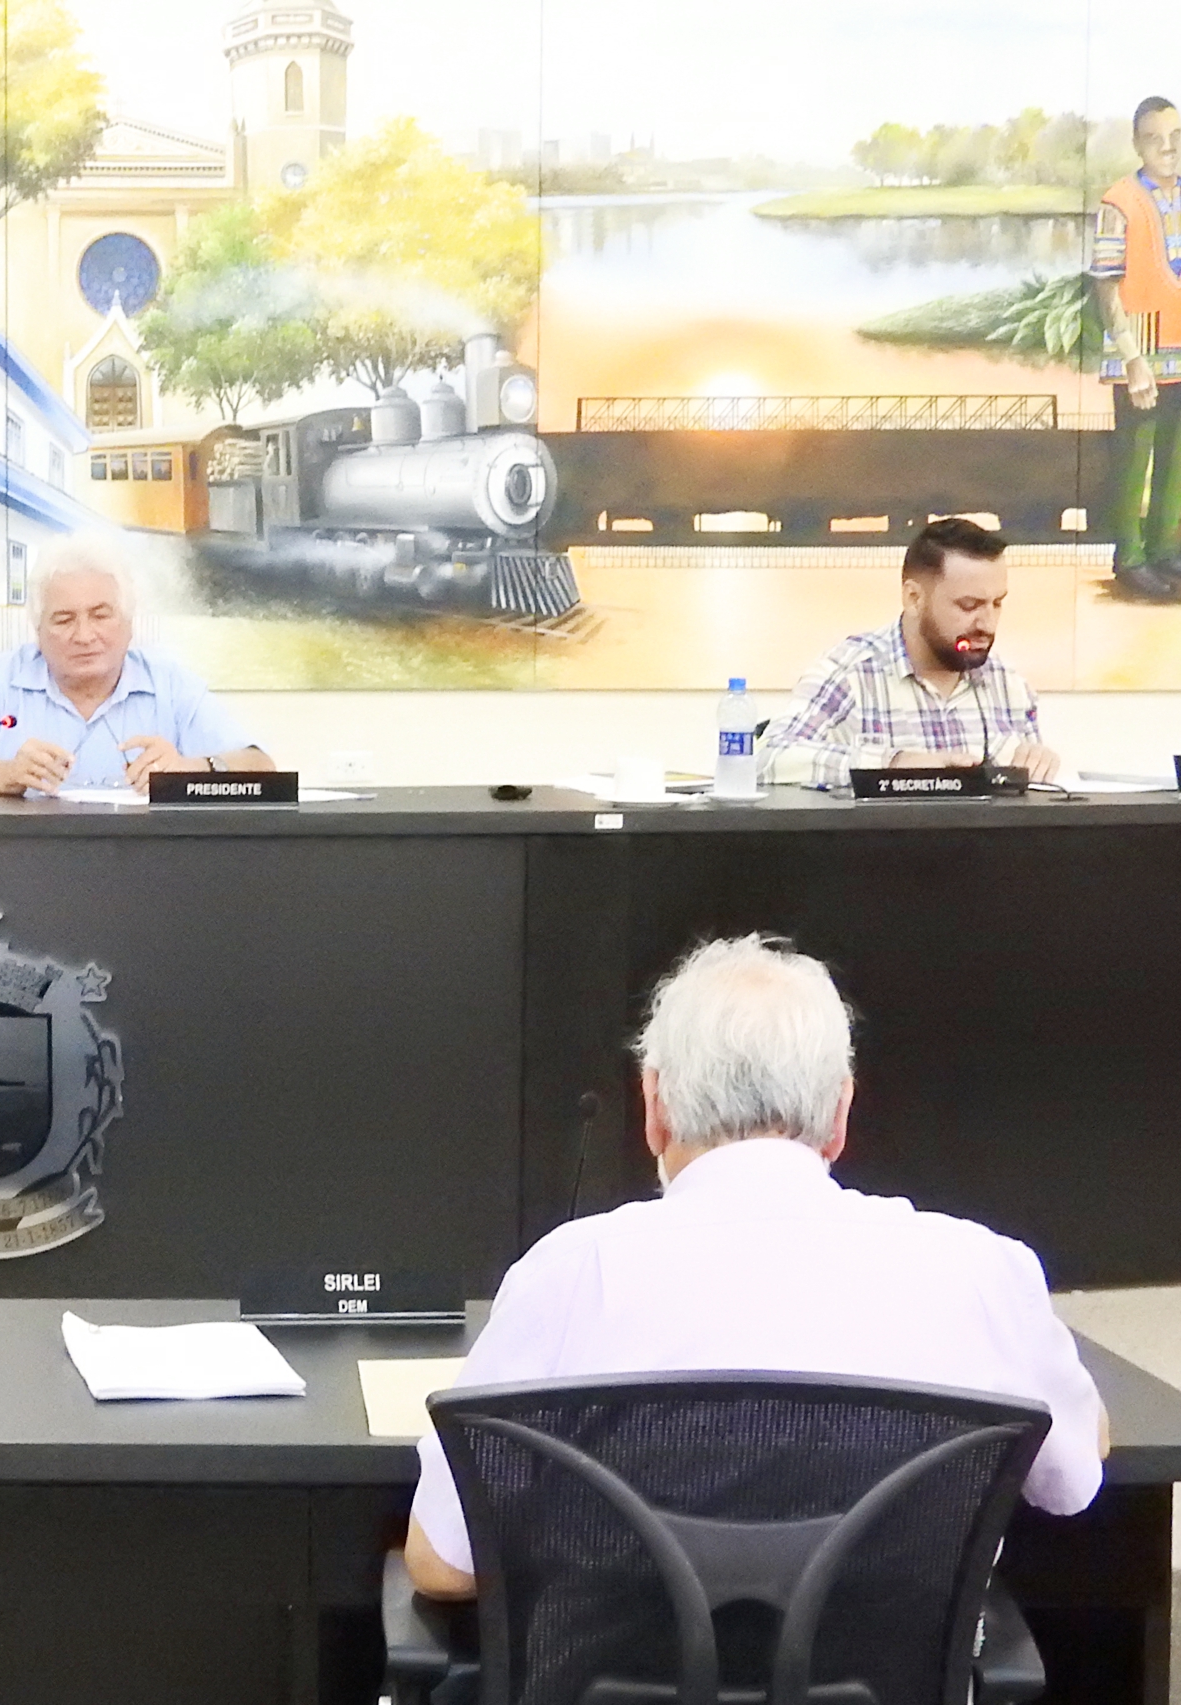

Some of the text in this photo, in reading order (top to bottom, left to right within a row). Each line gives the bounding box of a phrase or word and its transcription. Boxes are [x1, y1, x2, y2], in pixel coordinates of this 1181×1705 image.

[186, 782, 262, 796] PRESIDENTE
[892, 777, 962, 792] SECRETÁRIO
[323, 1273, 381, 1292] SIRLEI
[337, 1299, 368, 1313] DEM
